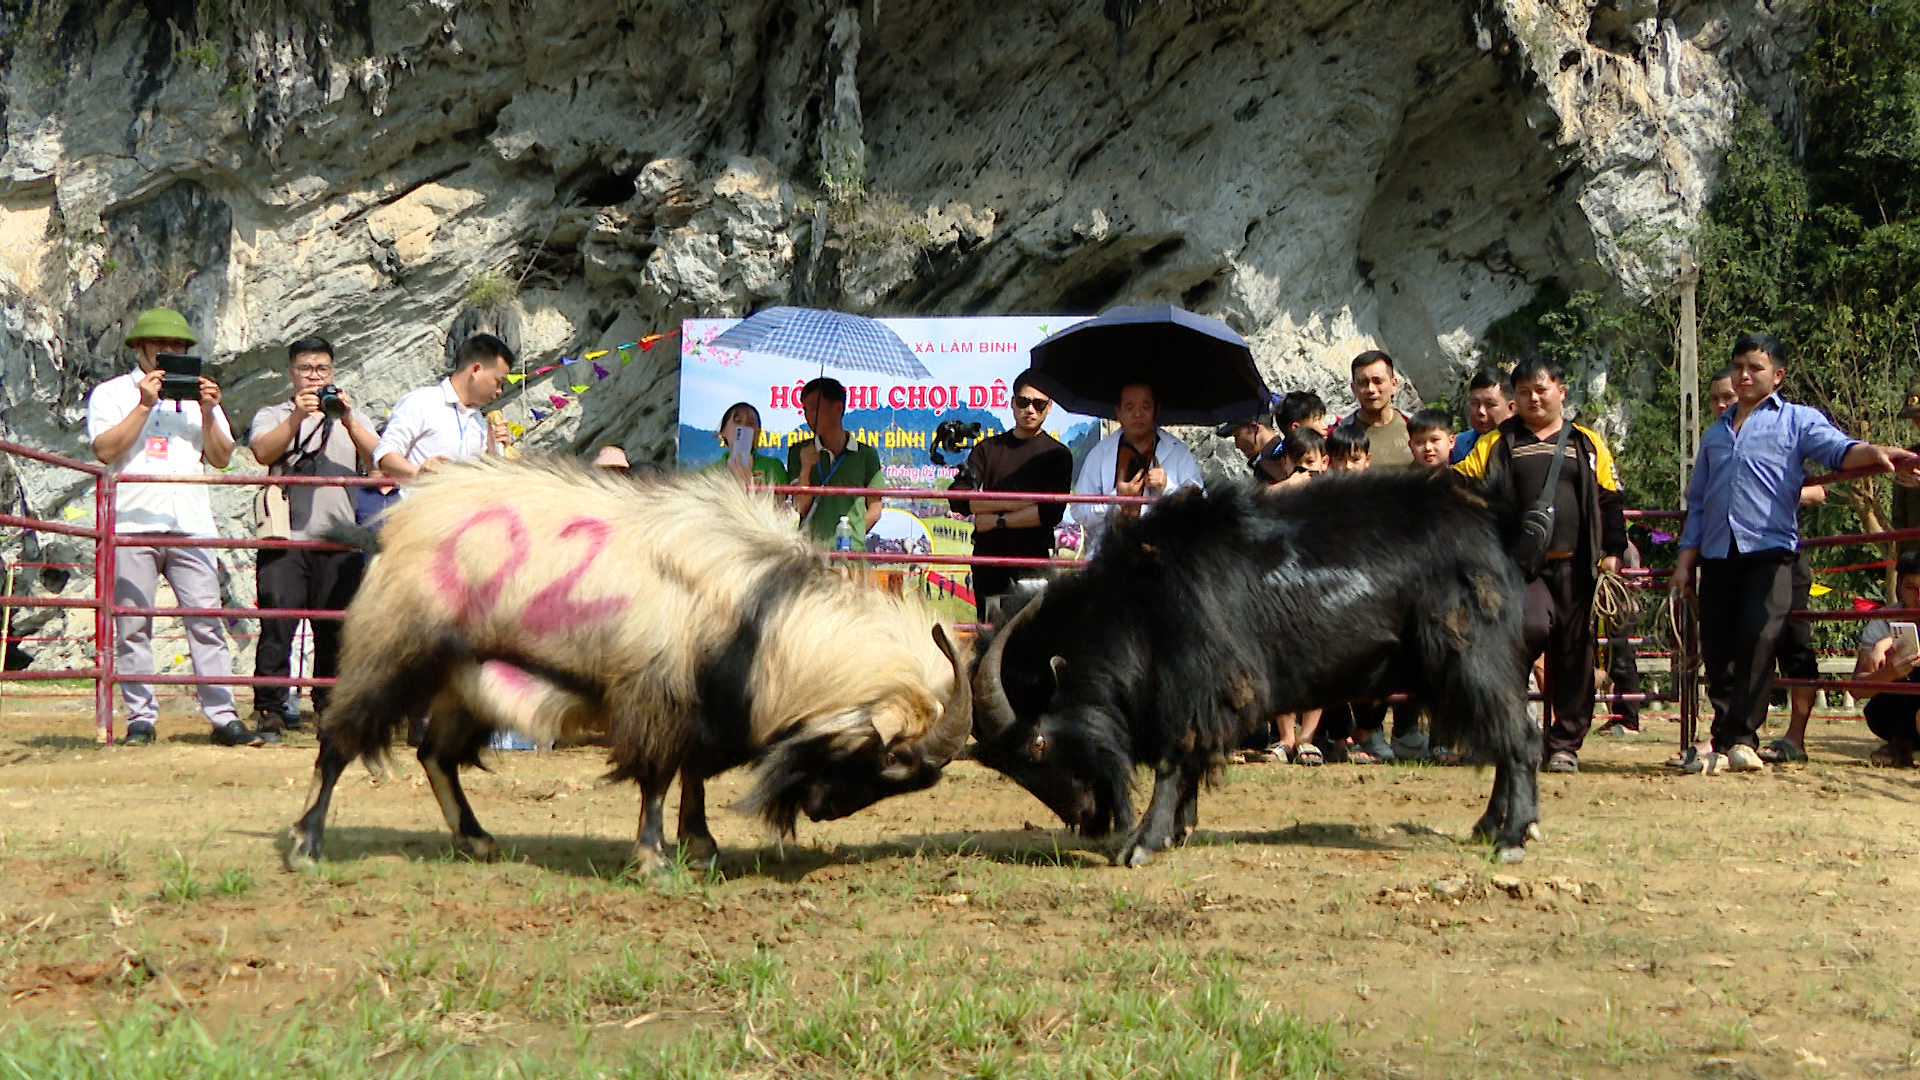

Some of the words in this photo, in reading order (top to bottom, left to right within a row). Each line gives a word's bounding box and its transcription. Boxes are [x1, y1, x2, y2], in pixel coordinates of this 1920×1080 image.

[915, 340, 935, 352] XÃ
[940, 339, 972, 352] LÂM
[979, 339, 1017, 352] BÌNH
[844, 386, 879, 409] HI
[888, 386, 959, 415] CHỌI
[967, 379, 1008, 409] DÊ
[921, 466, 936, 477] 02
[426, 502, 634, 638] 02
